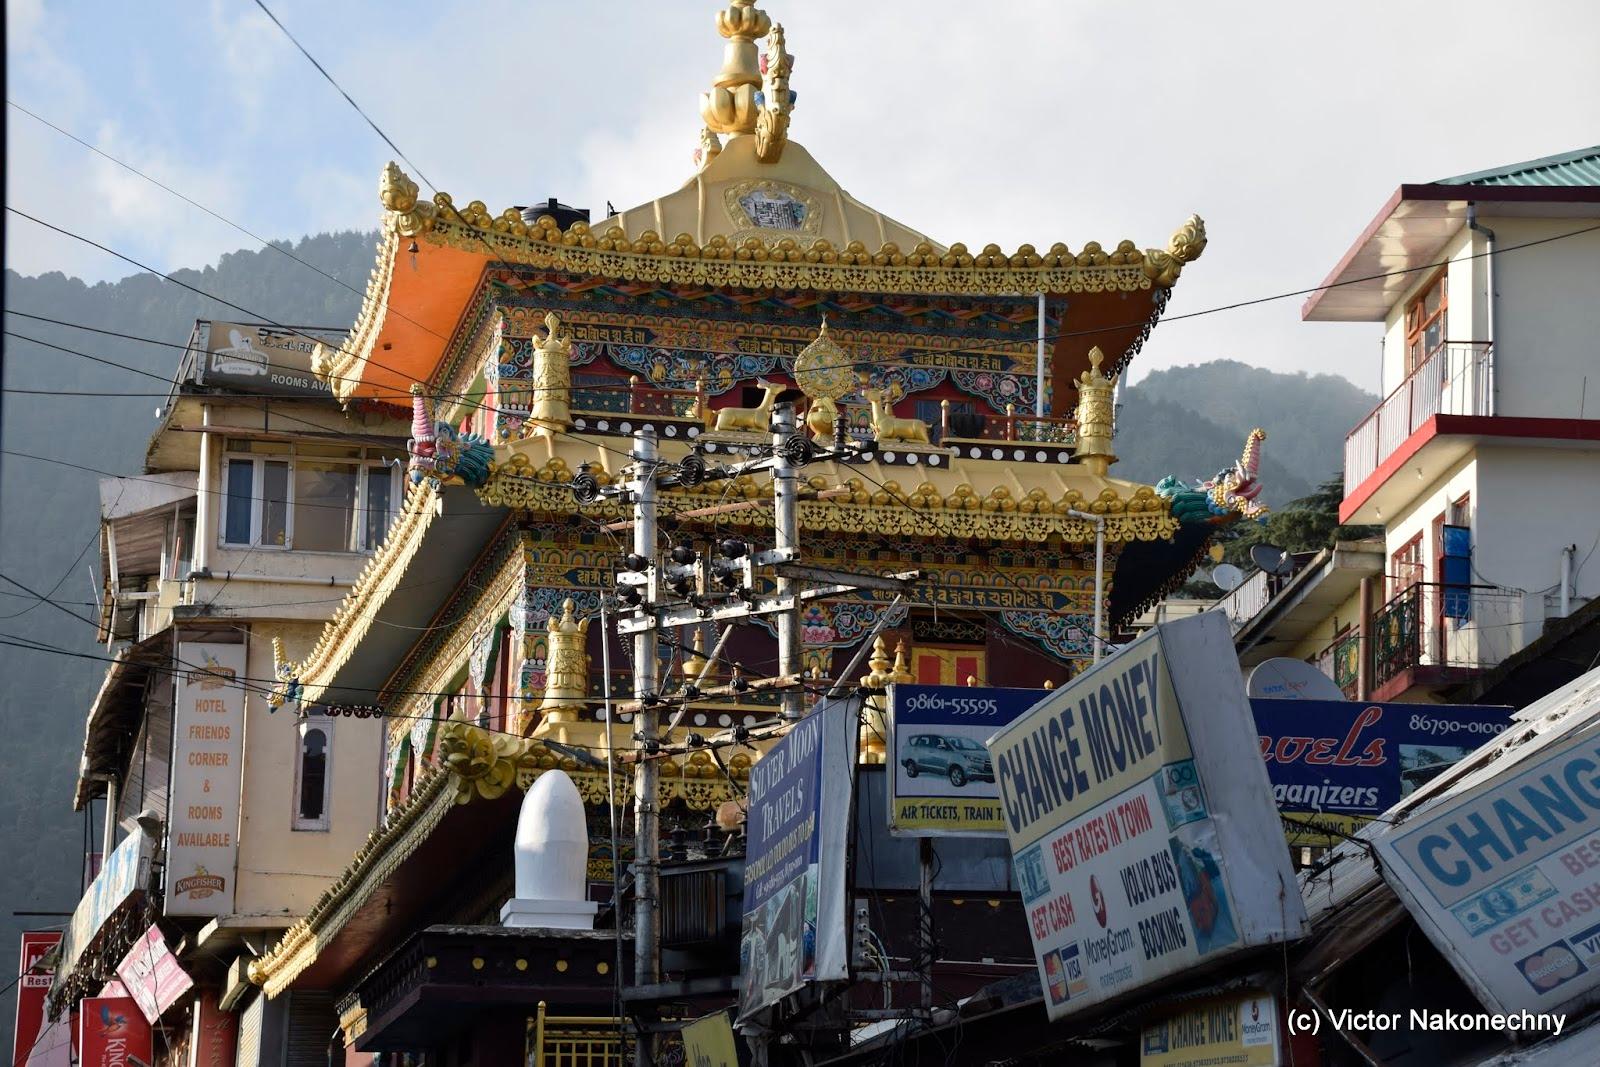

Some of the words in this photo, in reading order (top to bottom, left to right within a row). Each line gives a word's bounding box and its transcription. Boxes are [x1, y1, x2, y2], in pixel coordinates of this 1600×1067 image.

[271, 373, 308, 389] ROOMS
[311, 380, 332, 393] AVA
[195, 699, 227, 713] HOTEL
[905, 692, 998, 716] 98161-55595
[189, 725, 231, 740] FRIENDS
[998, 707, 1090, 834] CHANGE
[1078, 653, 1163, 784] MONEY
[188, 752, 229, 767] CORNER
[750, 749, 785, 807] SILVER
[787, 715, 820, 774] MOON
[203, 779, 210, 793] &
[1272, 779, 1379, 809] ganizers
[188, 806, 223, 820] ROOMS
[761, 778, 804, 843] TRAVELS
[901, 806, 918, 820] AIR
[920, 806, 960, 822] TICKETS,
[964, 806, 993, 821] TRAIN
[1417, 749, 1600, 888] CHANG
[177, 832, 231, 848] AVAILABLE
[1052, 831, 1079, 875] BEST
[1075, 816, 1110, 863] RATES
[1105, 809, 1122, 847] IN
[1118, 794, 1153, 841] TOWN
[176, 879, 223, 893] KINGFISHER
[1120, 857, 1158, 908] VOLVO
[1151, 848, 1178, 896] BUS
[1031, 901, 1049, 941] GET
[1049, 892, 1076, 933] CASH
[1083, 927, 1136, 966] MoneyGram
[1138, 906, 1188, 961] BOOKING
[1489, 916, 1539, 956] GET
[1066, 958, 1082, 981] VISA
[1171, 1011, 1206, 1050] CHANGE
[1208, 1002, 1239, 1044] MONEY
